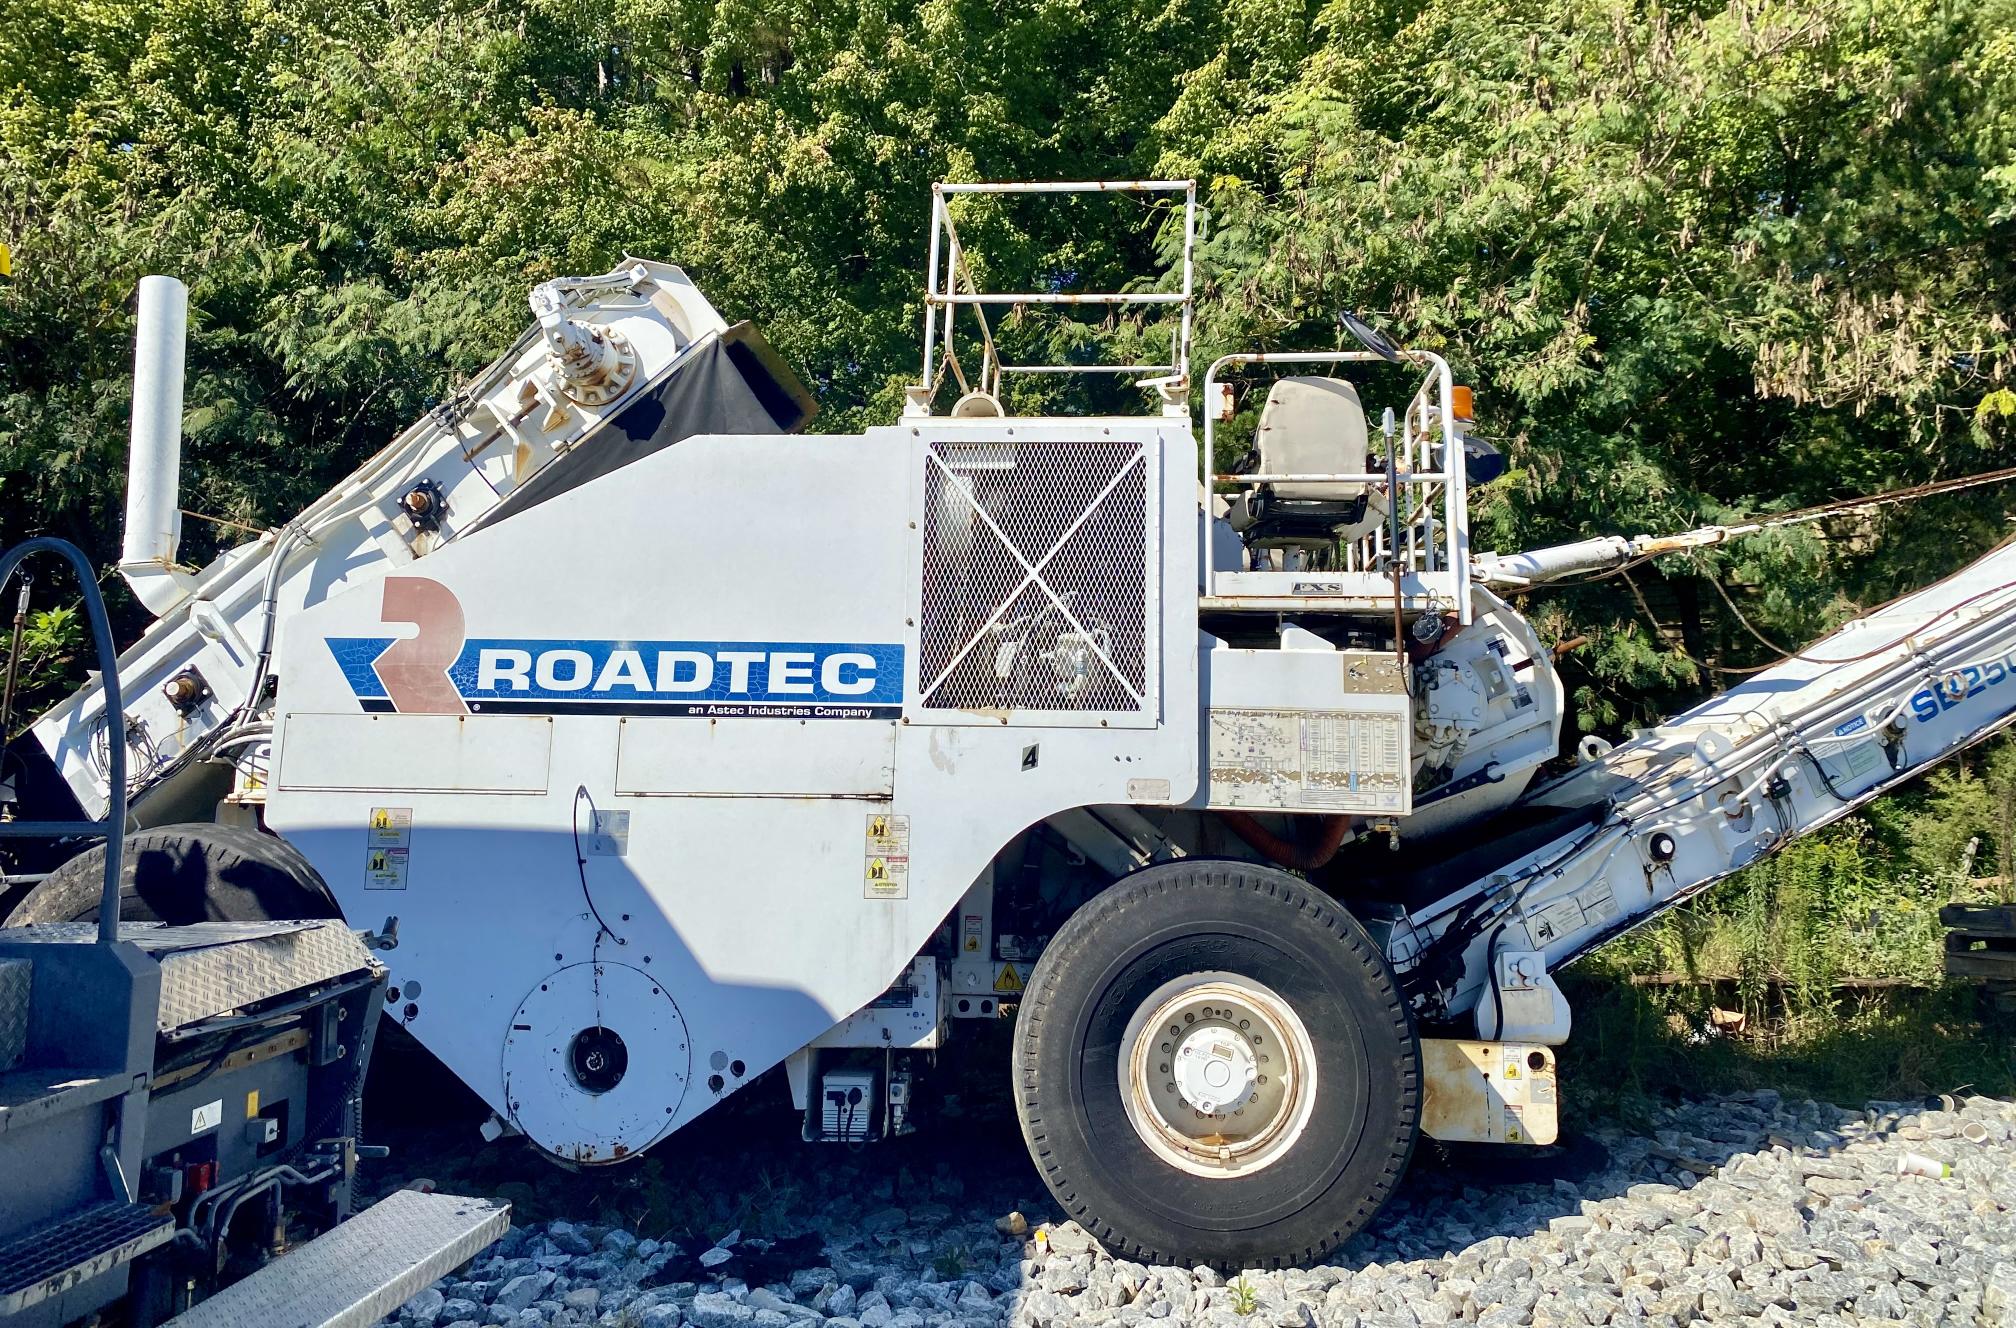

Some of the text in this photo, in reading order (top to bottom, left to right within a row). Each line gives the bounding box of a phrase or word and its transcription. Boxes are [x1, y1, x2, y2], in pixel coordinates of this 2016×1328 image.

[477, 648, 877, 696] ROADTEC
[688, 705, 873, 719] an Astec Industries Company
[1022, 745, 1038, 768] 4
